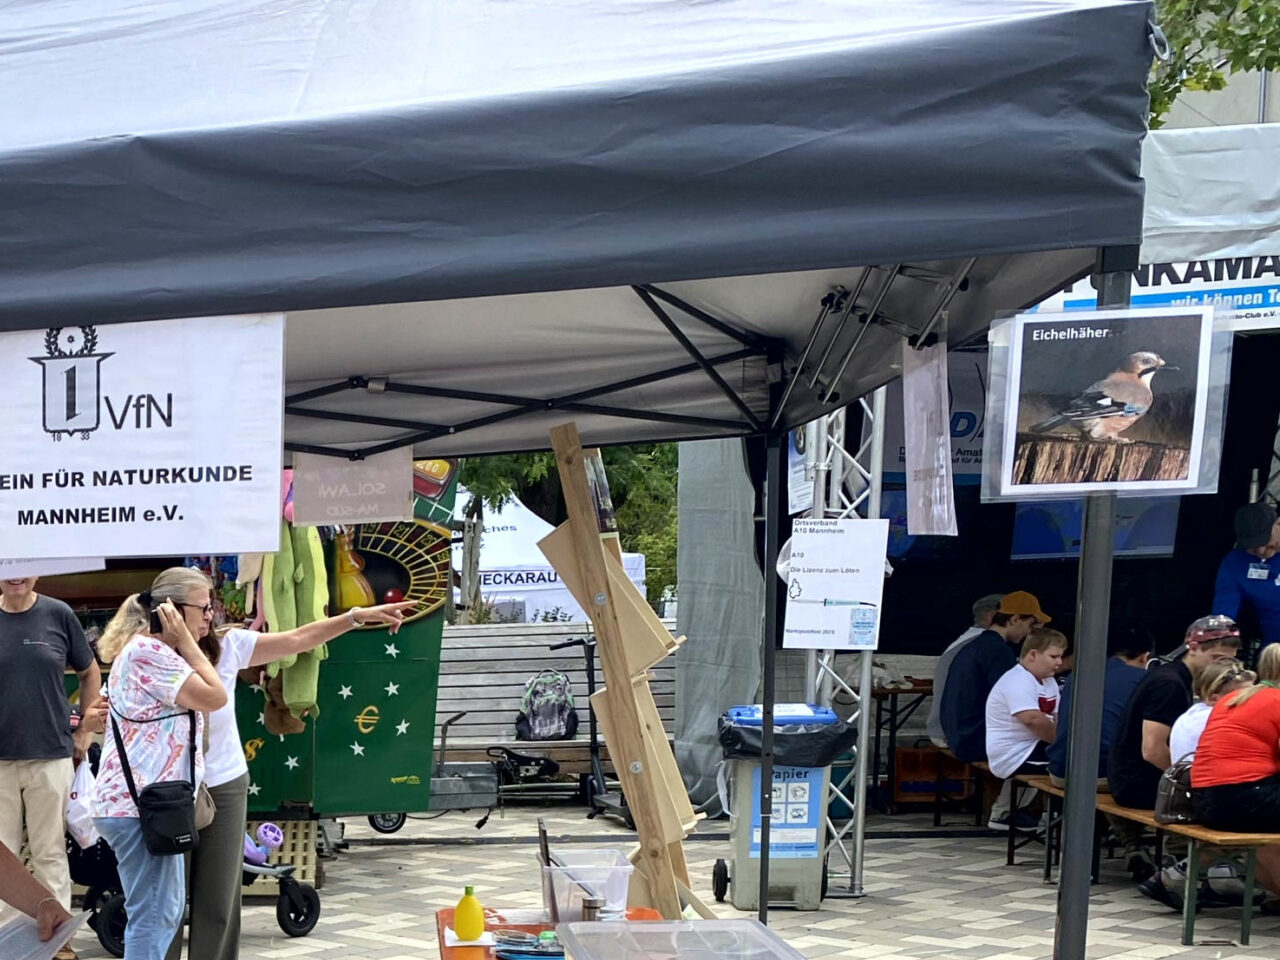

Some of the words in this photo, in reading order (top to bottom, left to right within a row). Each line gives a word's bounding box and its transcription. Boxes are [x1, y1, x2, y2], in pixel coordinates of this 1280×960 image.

[1033, 327, 1109, 341] Eichelhäher
[104, 392, 173, 431] VfN
[80, 432, 90, 441] 33
[42, 469, 85, 489] FÜR
[92, 465, 253, 487] NATURKUNDE
[17, 506, 136, 526] MANNHEIM
[143, 505, 184, 522] e.V.
